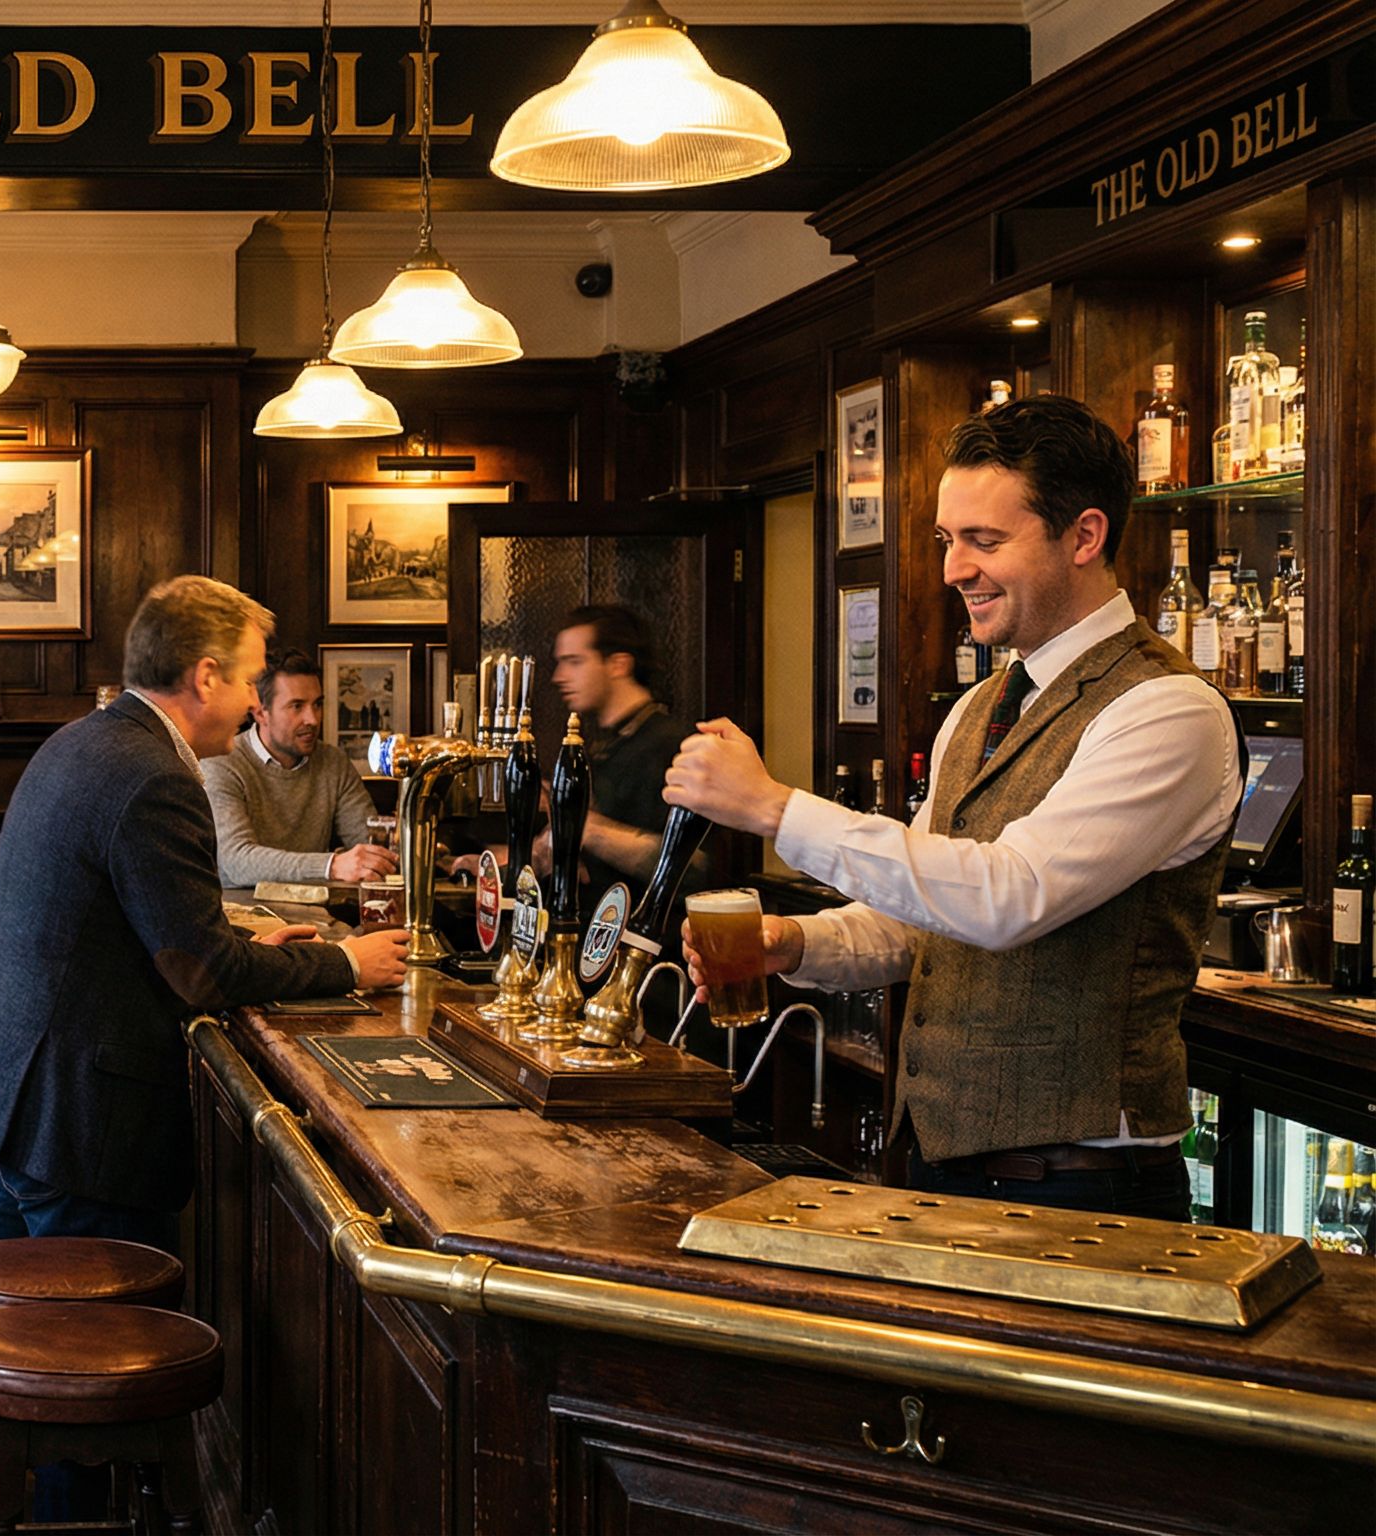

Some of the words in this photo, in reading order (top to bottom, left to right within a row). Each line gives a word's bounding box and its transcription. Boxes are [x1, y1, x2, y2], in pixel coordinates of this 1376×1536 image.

[150, 50, 475, 144] BELL
[1090, 159, 1147, 228] THE
[1155, 127, 1221, 199] OLD
[1231, 82, 1318, 168] BELL
